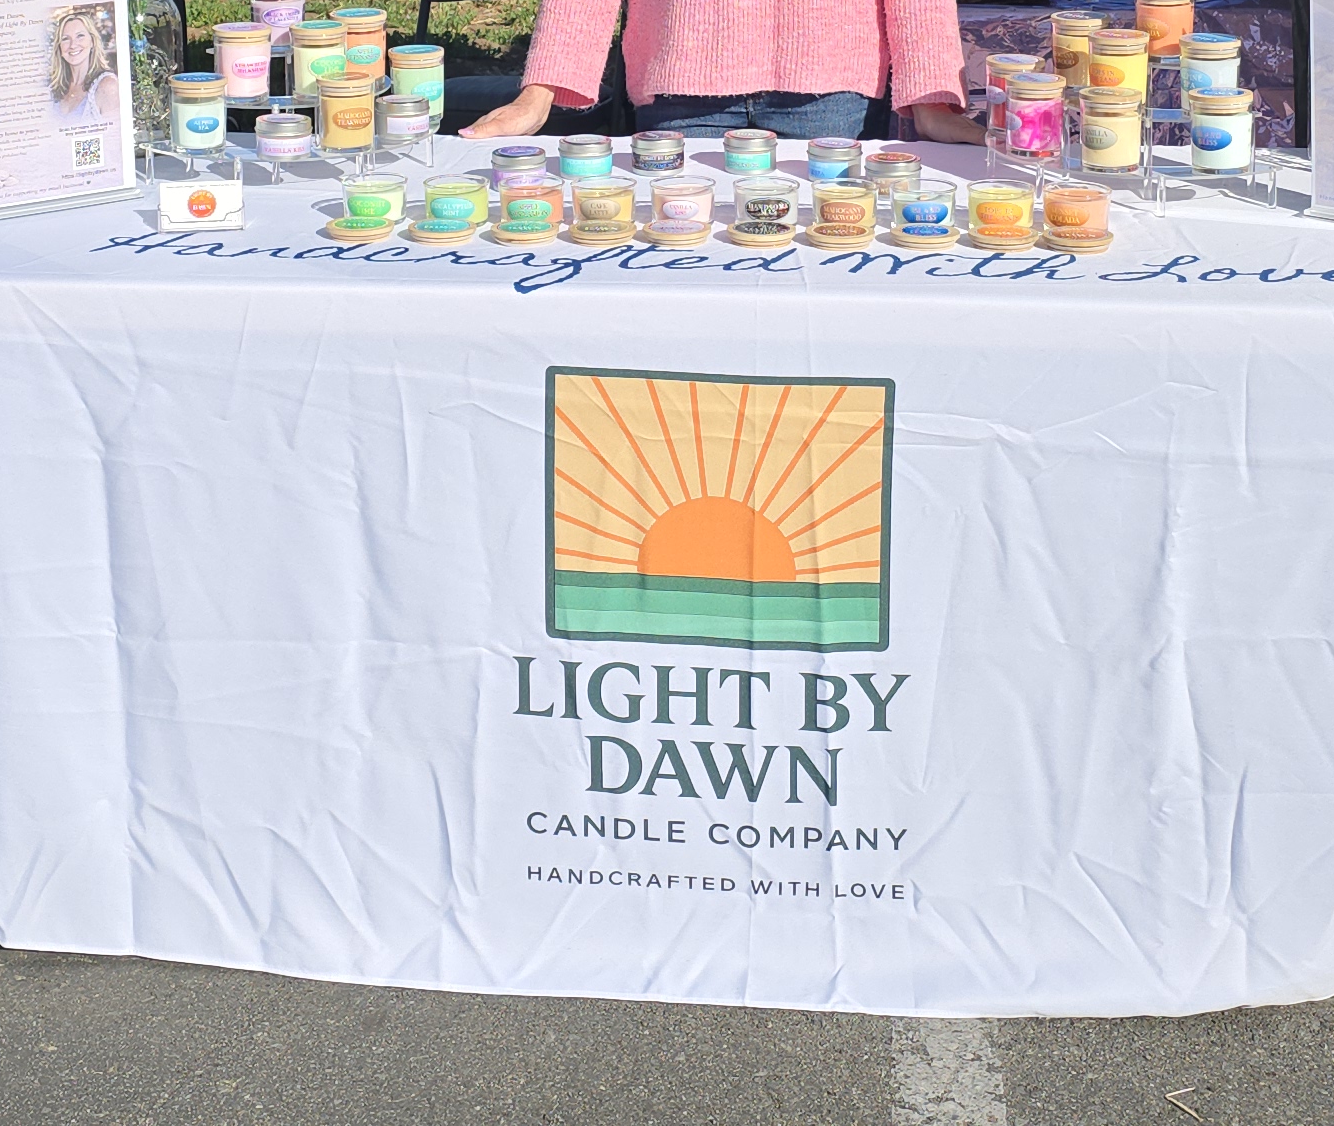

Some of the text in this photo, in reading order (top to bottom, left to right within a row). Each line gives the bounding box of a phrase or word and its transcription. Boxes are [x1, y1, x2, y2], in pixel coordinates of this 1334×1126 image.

[823, 206, 862, 214] MAHOGANY
[824, 213, 862, 221] TEAKWOOD
[89, 231, 805, 295] Handcrafted
[818, 250, 1087, 284] With
[512, 656, 912, 734] LIGHT BY
[585, 735, 844, 807] DAWN
[526, 811, 908, 852] CANDLE COMPANY
[526, 865, 905, 901] HANDCRAFTED WITH LOVE
